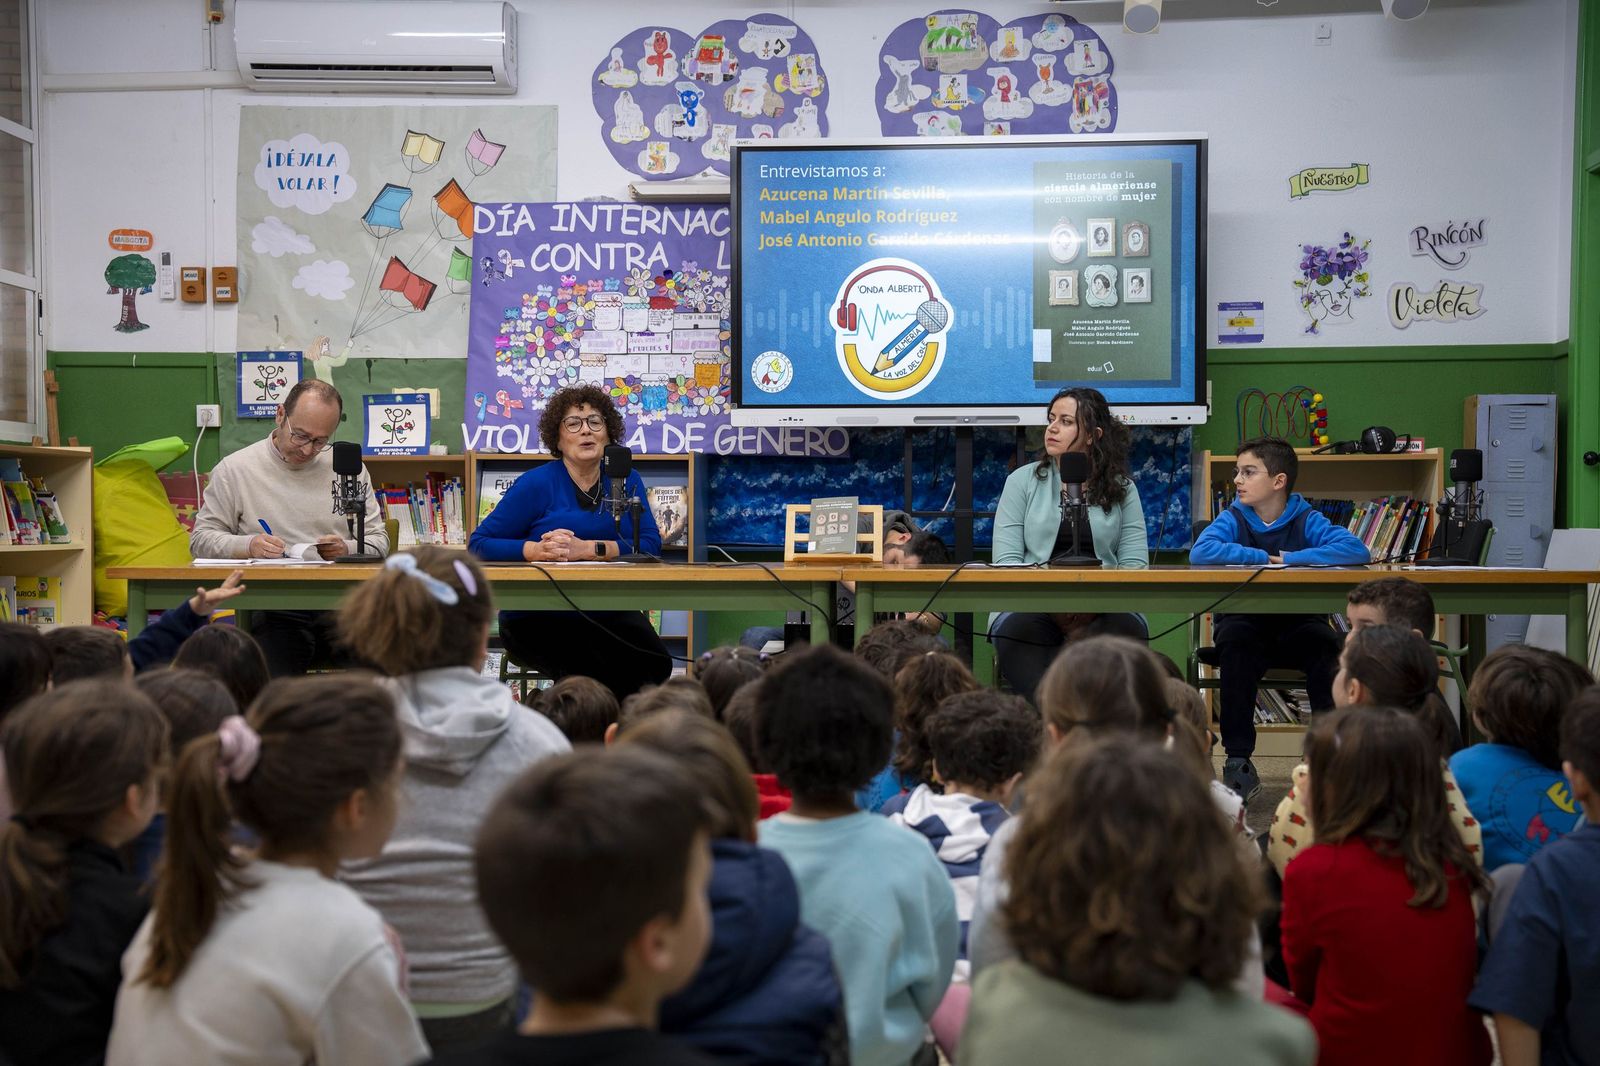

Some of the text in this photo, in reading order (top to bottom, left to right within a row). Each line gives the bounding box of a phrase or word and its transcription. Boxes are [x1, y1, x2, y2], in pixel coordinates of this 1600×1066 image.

[267, 148, 338, 168] ¡DÉJALA
[760, 164, 886, 179] Entrevistamos a:
[1065, 171, 1135, 182] Historia de la
[1304, 170, 1355, 187] NUESTRO
[760, 185, 951, 203] Azucena Martín Sevilla,
[1090, 181, 1157, 191] almeriense
[1065, 193, 1104, 204] nombre
[1106, 193, 1119, 203] de
[1121, 192, 1157, 203] mujer
[473, 203, 536, 237] DÍA
[760, 208, 959, 228] Mabel Angulo Rodríguez
[758, 233, 793, 251] José
[797, 233, 863, 248] Antonio
[1410, 219, 1485, 266] RINCÓN
[530, 241, 669, 273] CONTRA
[1395, 282, 1481, 321] Violeta
[883, 371, 893, 379] LA
[894, 368, 908, 378] VOZ
[907, 359, 920, 371] DEL
[661, 422, 706, 455] DE
